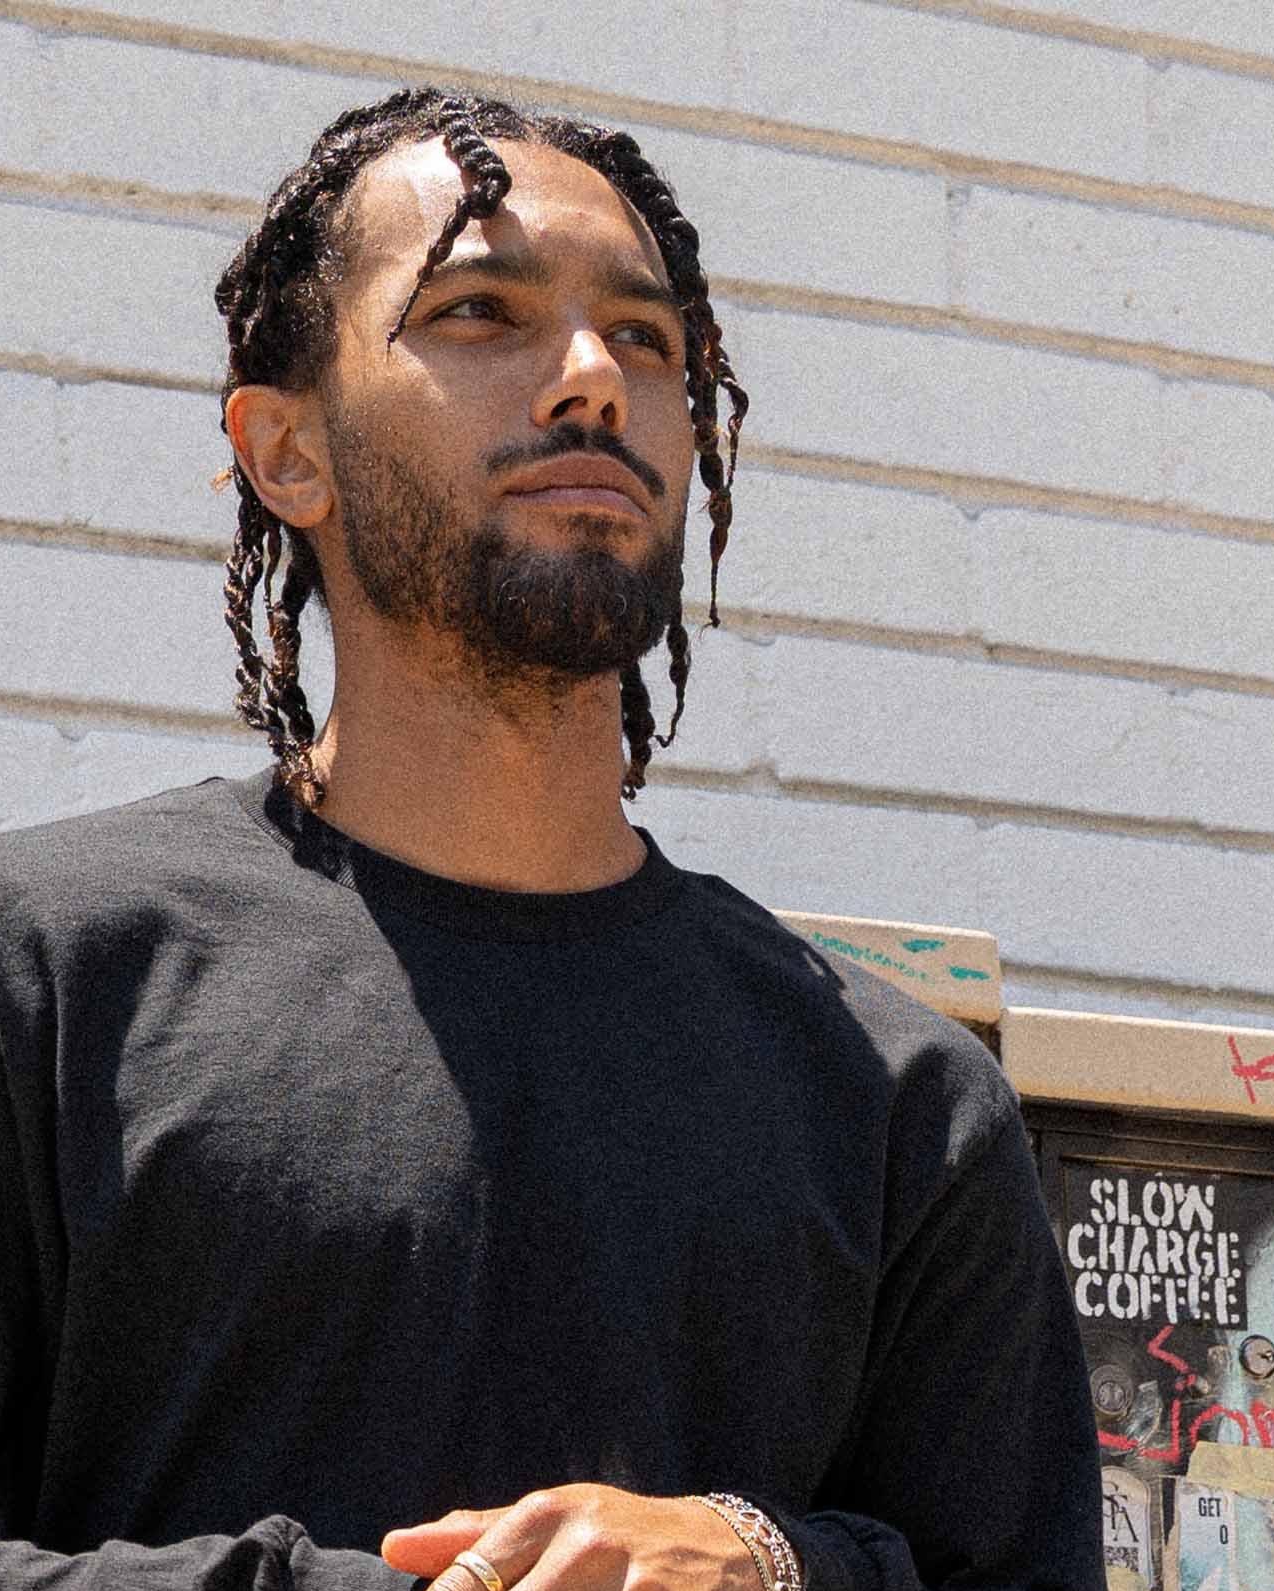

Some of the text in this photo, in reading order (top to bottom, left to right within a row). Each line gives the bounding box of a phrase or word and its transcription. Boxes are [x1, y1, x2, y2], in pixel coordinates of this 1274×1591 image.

[1089, 1178, 1215, 1231] SLOW
[1067, 1223, 1241, 1276] CHARGE
[1075, 1270, 1241, 1325] COFFEE
[1199, 1497, 1222, 1518] GET
